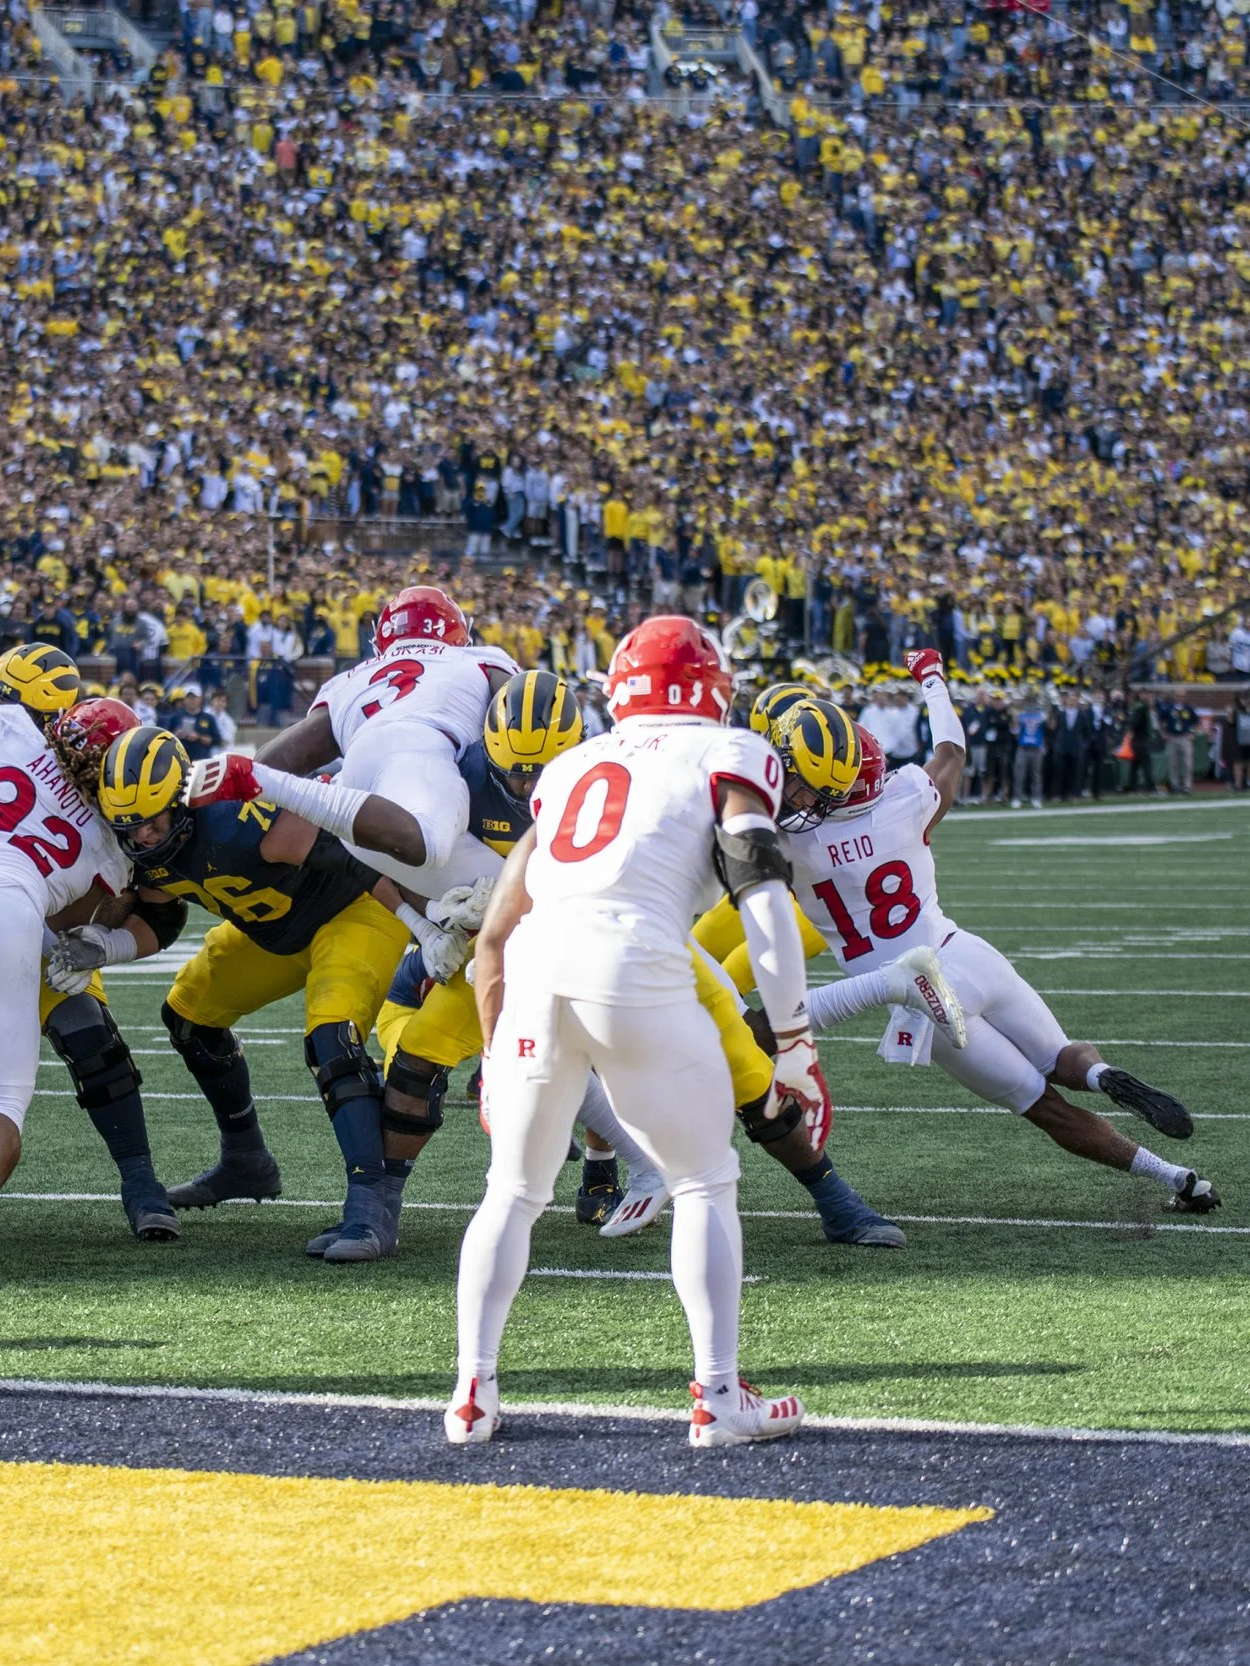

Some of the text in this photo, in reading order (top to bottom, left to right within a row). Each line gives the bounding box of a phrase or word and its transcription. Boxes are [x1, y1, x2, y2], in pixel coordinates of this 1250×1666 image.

[423, 618, 433, 633] 3
[668, 684, 681, 705] 0
[522, 764, 533, 772] M
[764, 754, 779, 790] 0
[26, 753, 94, 828] AHANOTU
[121, 815, 133, 823] M
[550, 761, 632, 864] 0
[827, 834, 874, 868] REID
[811, 859, 921, 963] 18
[518, 1038, 536, 1058] R
[897, 1031, 913, 1047] R
